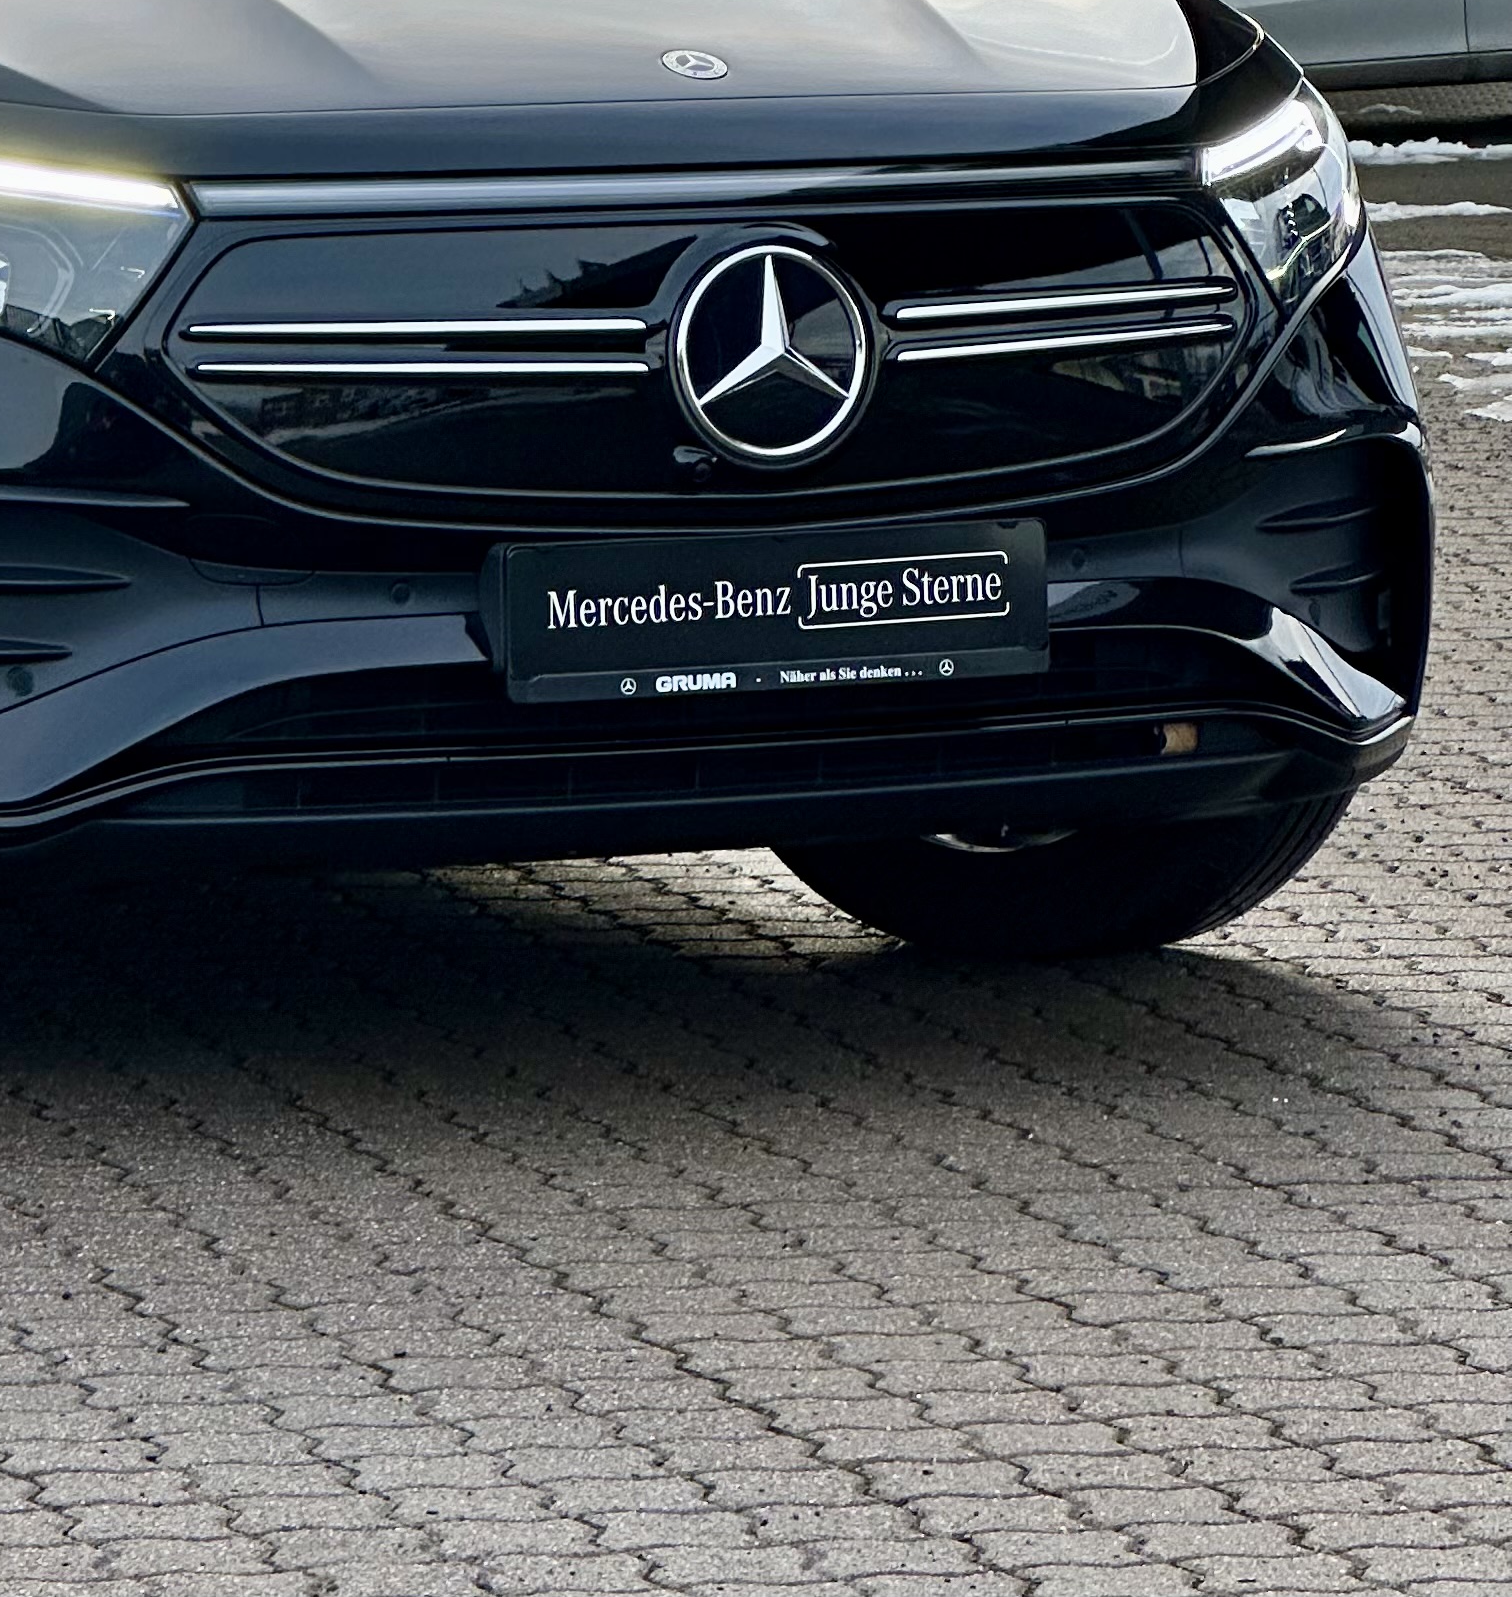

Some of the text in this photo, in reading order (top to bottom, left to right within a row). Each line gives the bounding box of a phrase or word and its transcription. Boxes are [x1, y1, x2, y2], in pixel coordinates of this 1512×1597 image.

[547, 567, 1002, 630] Mercedes-Benz Junge Sterne
[655, 671, 737, 693] GRUMA
[779, 669, 817, 684] Näher
[819, 668, 836, 682] als
[838, 666, 857, 681] Sie
[859, 664, 902, 680] denken
